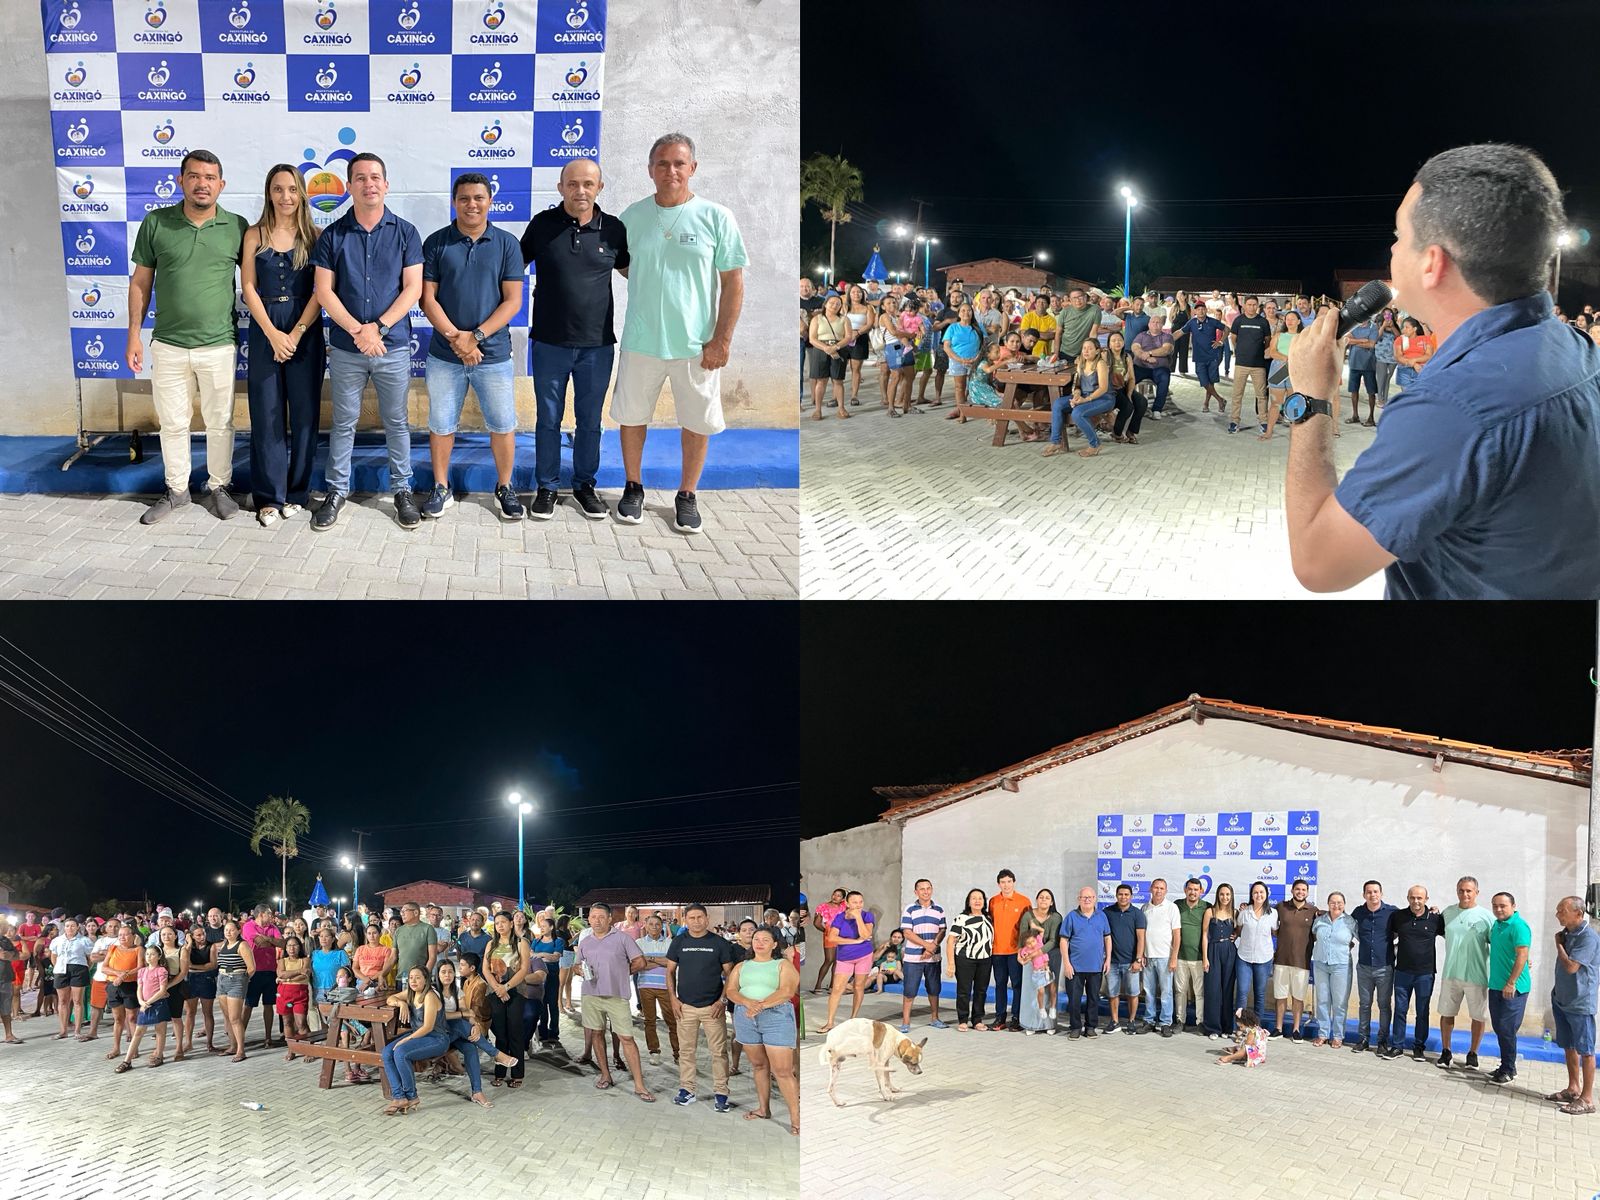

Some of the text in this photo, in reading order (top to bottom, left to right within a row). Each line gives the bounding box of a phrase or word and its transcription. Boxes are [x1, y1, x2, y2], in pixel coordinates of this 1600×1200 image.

[50, 32, 98, 43] CAXINGÓ
[134, 30, 183, 42] CAXINGÓ
[218, 32, 268, 43] CAXINGÓ
[304, 32, 352, 44] CAXINGÓ
[387, 32, 436, 44] CAXINGÓ
[470, 32, 518, 44] CAXINGÓ
[554, 31, 603, 43] CAXINGÓ
[54, 89, 102, 101] CAXINGÓ
[138, 90, 186, 101] CAXINGÓ
[222, 90, 270, 102] CAXINGÓ
[305, 90, 352, 102] CAXINGÓ
[387, 90, 435, 102] CAXINGÓ
[469, 90, 517, 102] CAXINGÓ
[552, 89, 600, 102] CAXINGÓ
[58, 145, 106, 157] CAXINGÓ
[142, 146, 190, 158] CAXINGÓ
[468, 146, 516, 158] CAXINGÓ
[550, 146, 598, 157] CAXINGÓ
[62, 201, 108, 212] CAXINGÓ
[67, 256, 112, 266] CAXINGÓ
[72, 308, 114, 319] CAXINGÓ
[77, 360, 120, 370] CAXINGÓ
